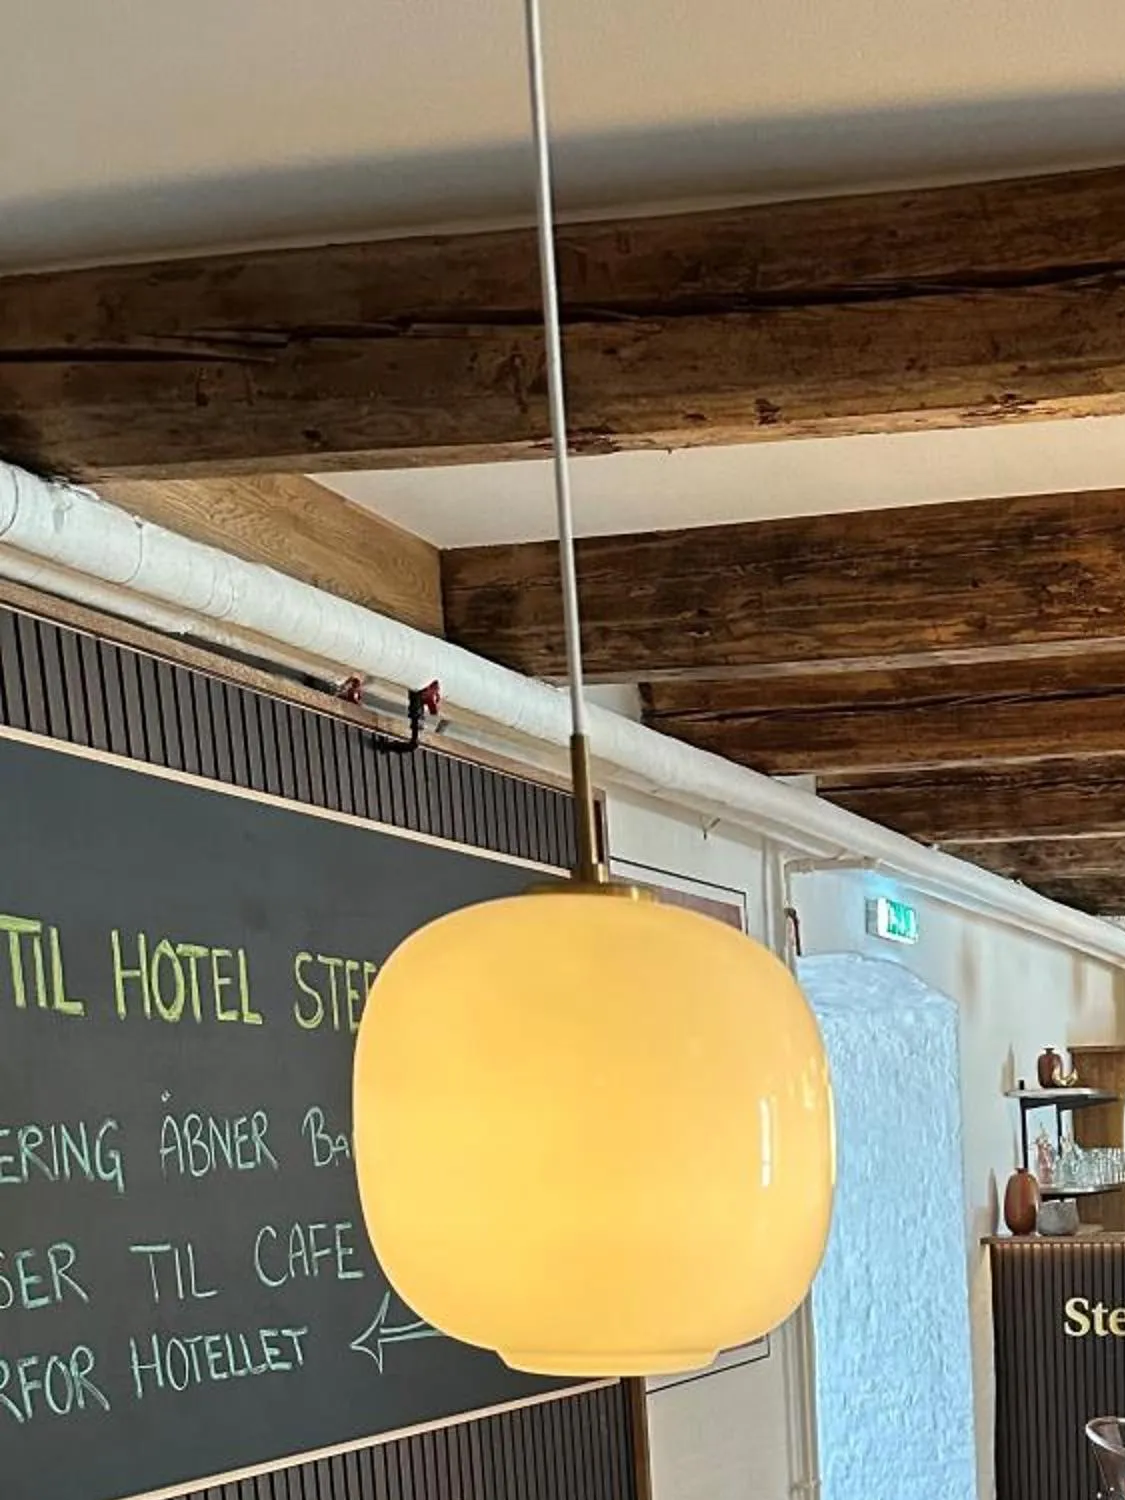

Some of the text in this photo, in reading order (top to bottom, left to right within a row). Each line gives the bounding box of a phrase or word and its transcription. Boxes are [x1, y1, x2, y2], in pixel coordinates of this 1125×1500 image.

[0, 914, 85, 1016] TIL
[111, 929, 263, 1025] HOTEL
[160, 1090, 279, 1178] ÅBNER
[129, 1243, 219, 1303] TIL
[254, 1221, 365, 1287] CAFE
[130, 1327, 308, 1398] HOTELLET
